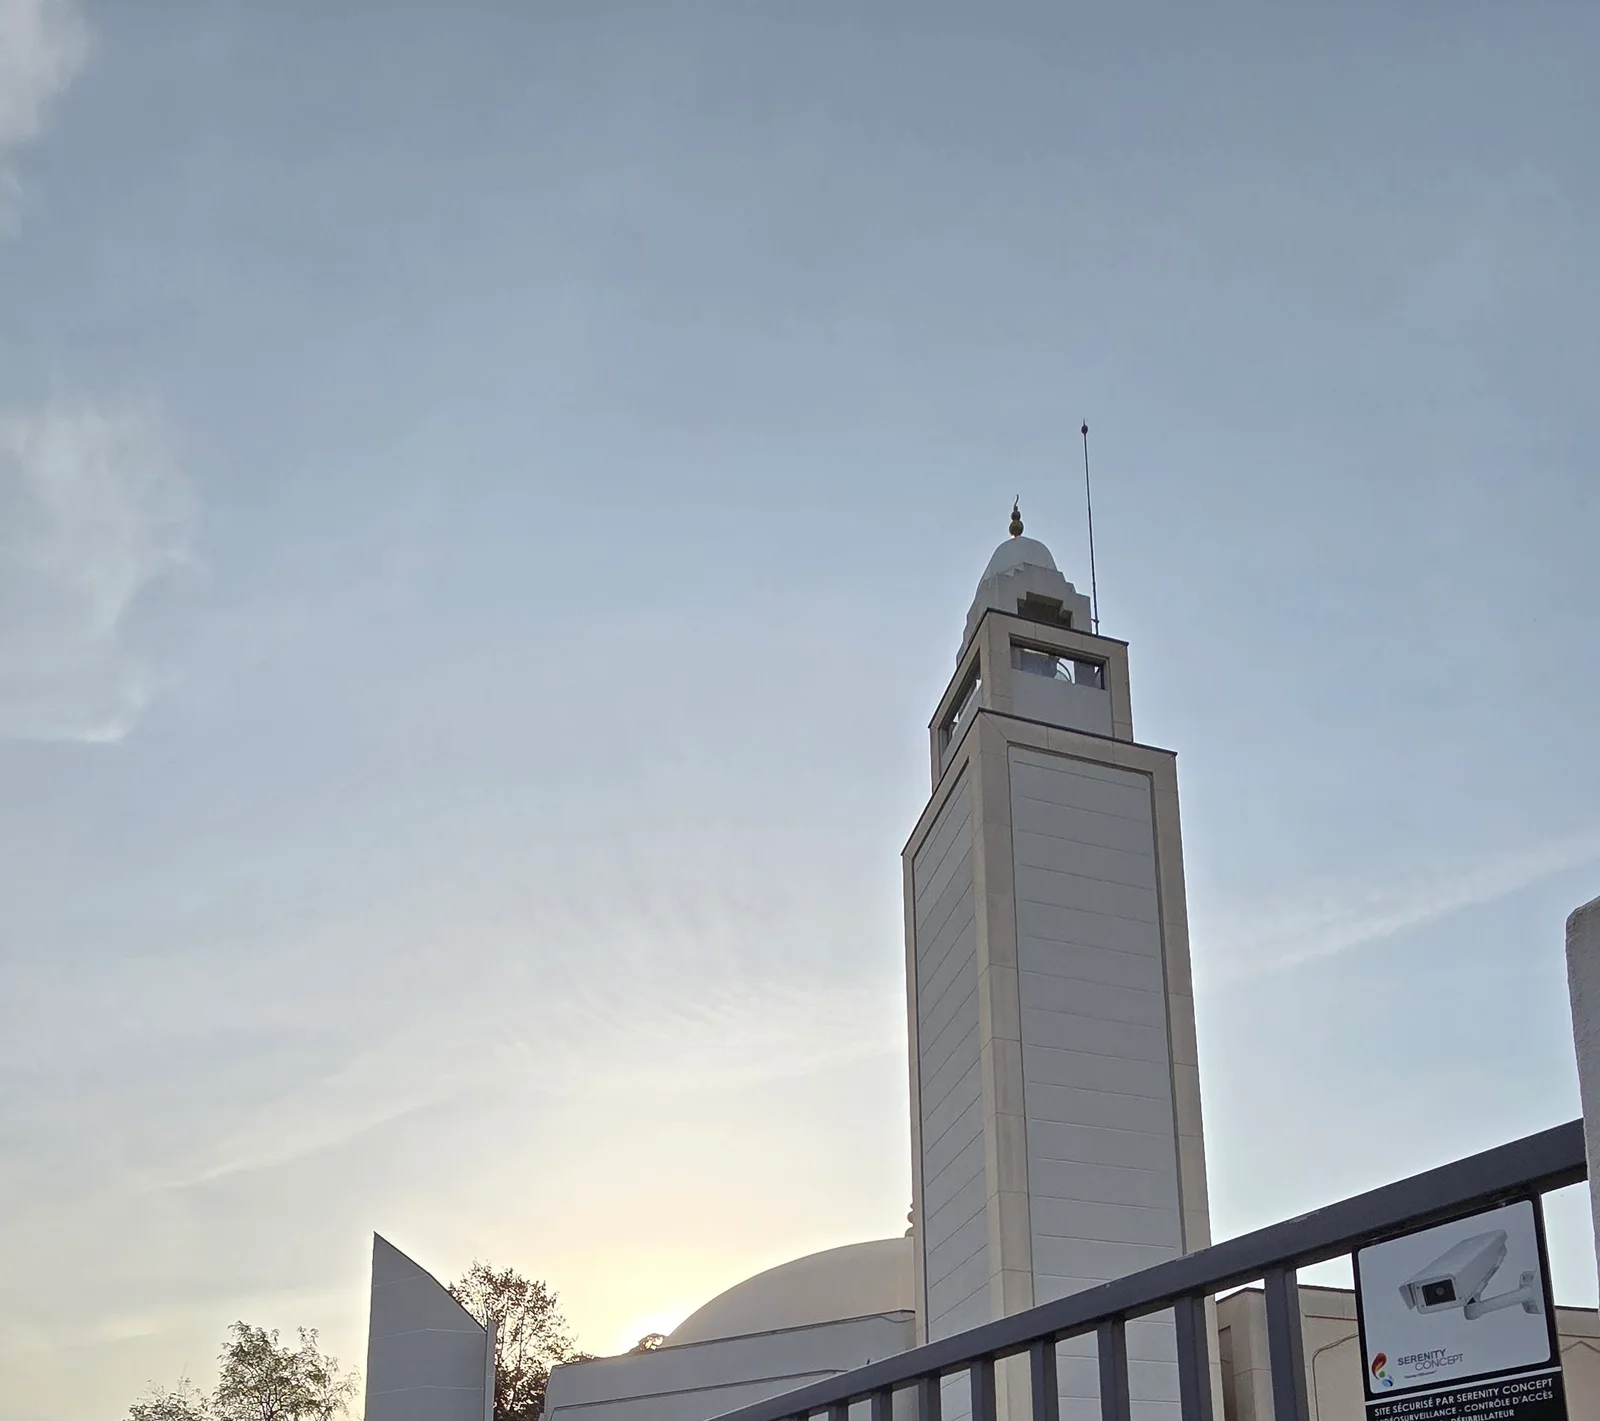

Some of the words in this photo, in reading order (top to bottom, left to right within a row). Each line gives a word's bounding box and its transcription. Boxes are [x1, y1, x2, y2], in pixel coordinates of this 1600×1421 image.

[1398, 1348, 1446, 1366] SERENITY
[1415, 1353, 1463, 1371] CONCEPT
[1374, 1406, 1390, 1417] SITE
[1392, 1397, 1433, 1413] SÉCURISÉ
[1436, 1396, 1454, 1406] PAR
[1457, 1388, 1499, 1402] SERENITY
[1502, 1378, 1553, 1394] CONCEPT
[1464, 1398, 1510, 1412] CONTRÔLE
[1512, 1390, 1553, 1405] D'ACCÈS
